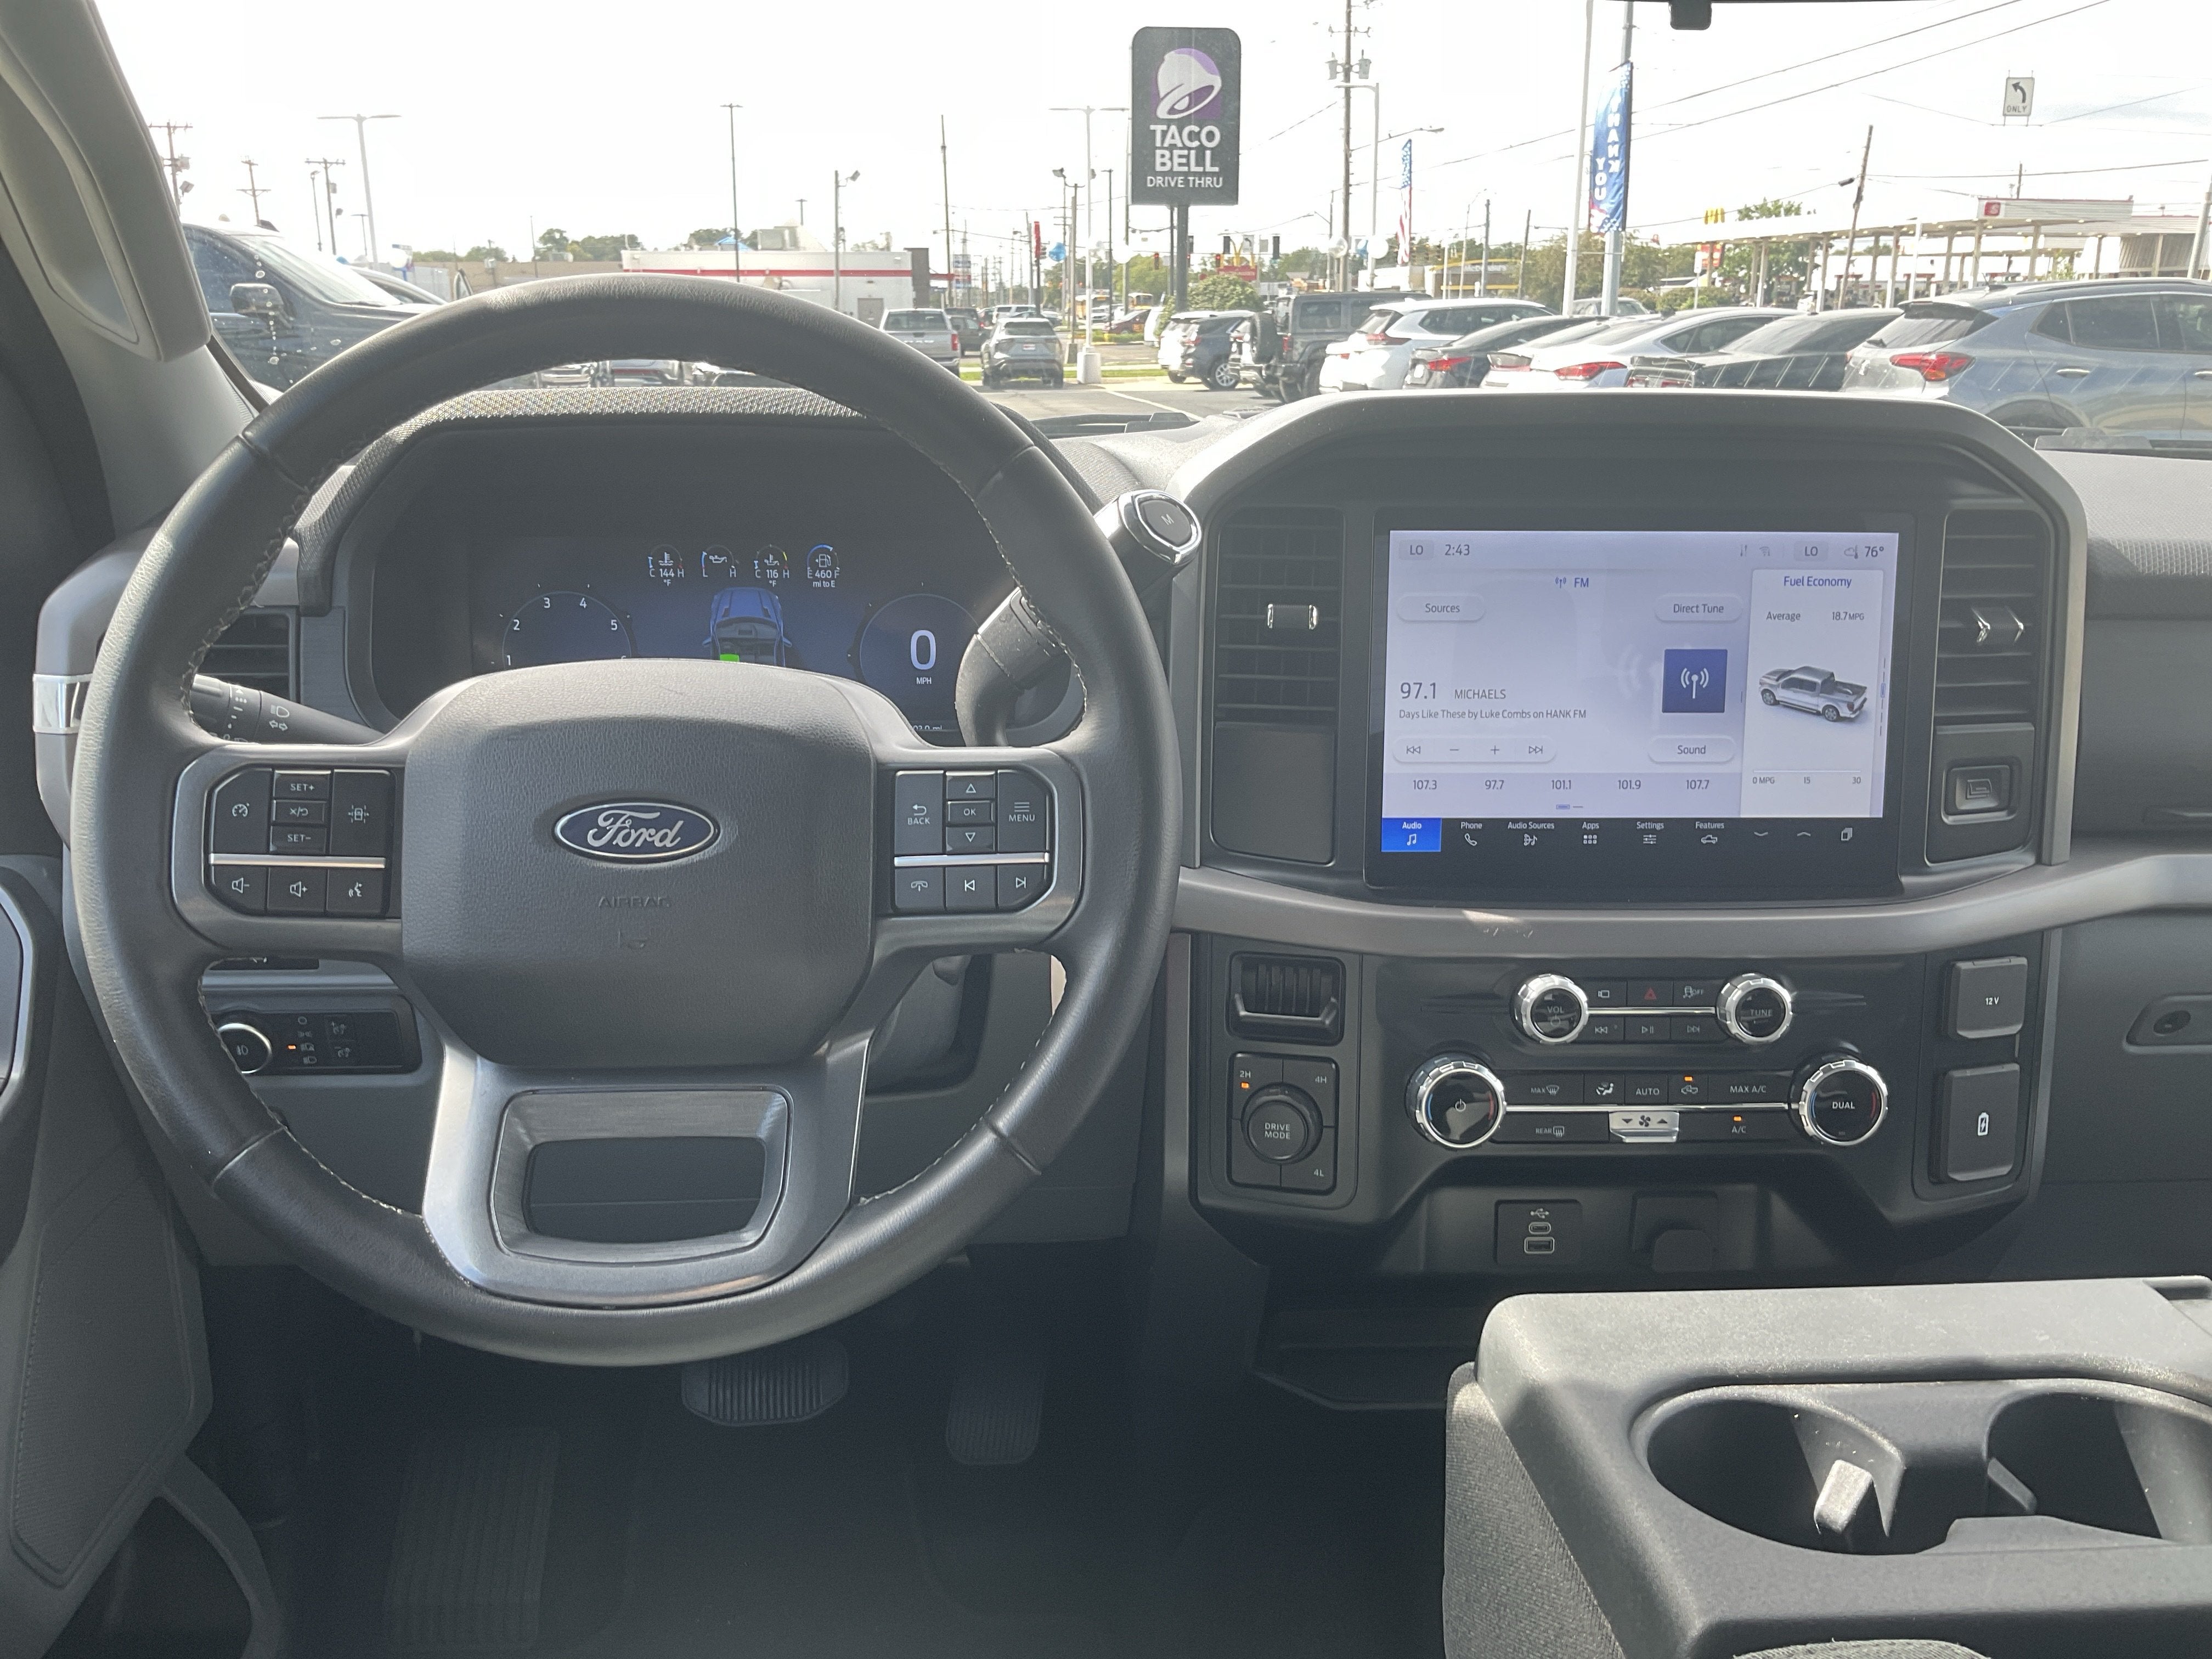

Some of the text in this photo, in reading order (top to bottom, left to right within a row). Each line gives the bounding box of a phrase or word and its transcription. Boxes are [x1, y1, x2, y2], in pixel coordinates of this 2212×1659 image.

[1149, 125, 1221, 148] TACO
[1155, 149, 1220, 172] BELL
[1147, 176, 1223, 188] DRIVE THRU
[1161, 514, 1175, 526] M
[1409, 544, 1470, 556] LO 2:43
[1804, 546, 1884, 557] LO 76°
[649, 568, 684, 578] C 144 H
[702, 568, 736, 578] L H
[755, 569, 789, 578] C 116 H
[807, 570, 840, 579] E 460 F
[1574, 578, 1589, 588] FM
[1784, 576, 1852, 588] Fuel Economy
[544, 597, 551, 608] 3
[579, 597, 587, 608] 4
[1425, 603, 1460, 613] Sources
[1673, 603, 1724, 613] Direct Tune
[1766, 612, 1801, 622] Average
[514, 619, 520, 630] 2
[611, 619, 618, 630] 5
[911, 630, 936, 670] 0
[506, 654, 511, 665] 1
[1400, 682, 1506, 699] 97.1 MICHAELS
[1399, 709, 1420, 720] Days
[1421, 709, 1438, 718] Like
[1440, 709, 1466, 718] These
[1468, 709, 1479, 720] by
[1480, 709, 1500, 718] Luke
[1502, 709, 1531, 718] Combs
[1546, 709, 1571, 718] HANK
[1573, 709, 1586, 718] FM
[1677, 745, 1706, 754] Sound
[1413, 780, 1709, 790] 107.3 97.7 101.1 101.9 107.7
[907, 817, 930, 825] BACK
[1008, 814, 1035, 822] MENU
[587, 810, 684, 848] Ford
[1582, 821, 1599, 830] Apps
[1637, 821, 1664, 830] Settings
[1265, 1123, 1290, 1131] DRIVE
[1265, 1131, 1291, 1139] MODE
[1314, 1169, 1324, 1177] 4L
